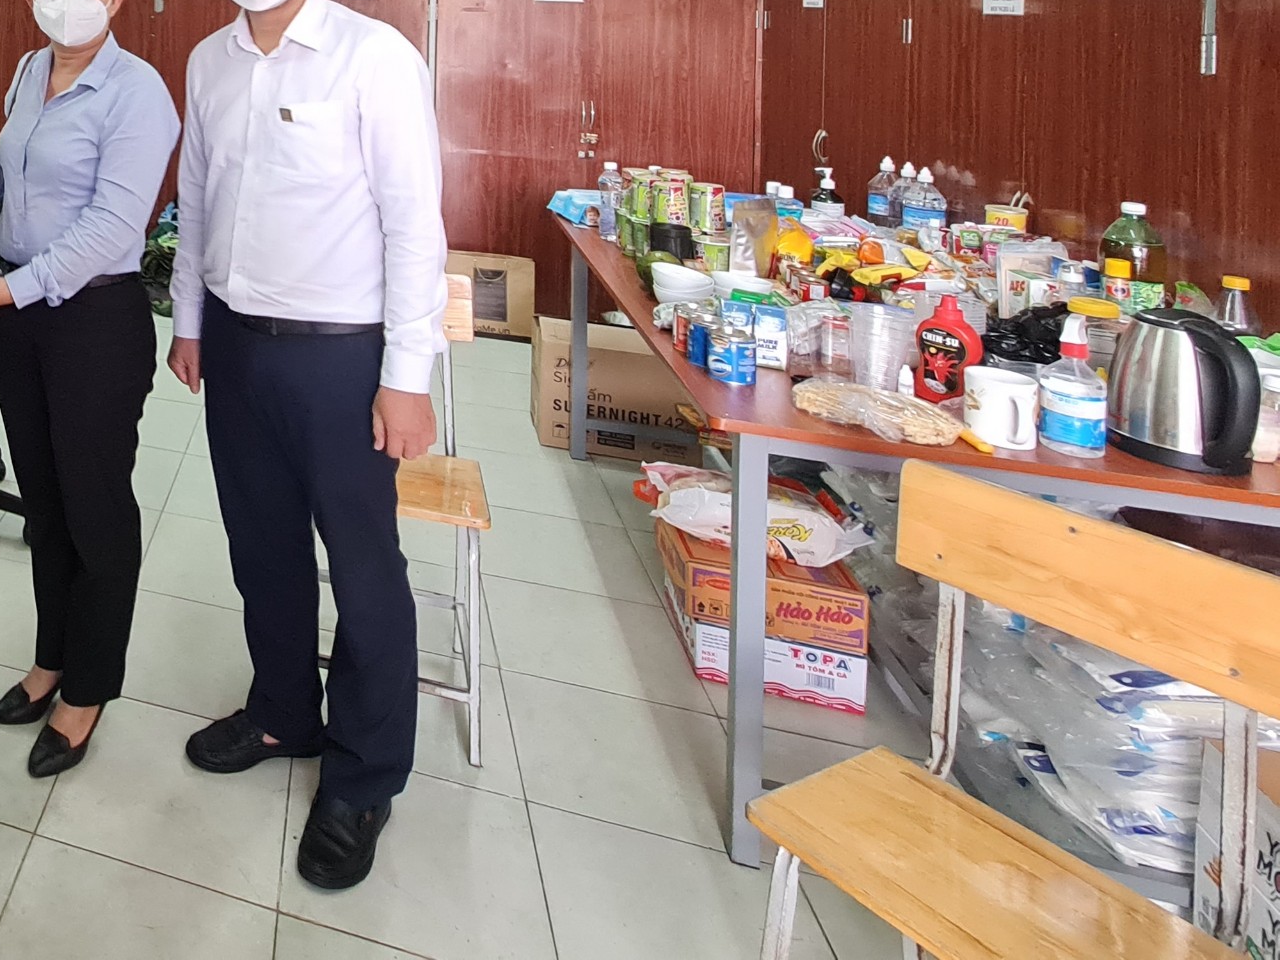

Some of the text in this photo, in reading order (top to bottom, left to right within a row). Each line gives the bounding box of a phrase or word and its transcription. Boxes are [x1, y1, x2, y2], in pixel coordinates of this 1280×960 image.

[995, 216, 1009, 226] 20
[1010, 280, 1025, 291] AFC
[757, 338, 778, 346] PURE
[922, 331, 959, 347] CHIN-SU
[757, 343, 777, 351] MILK
[553, 398, 662, 427] SUERNIGHT
[775, 601, 853, 625] Hảo Hảo
[789, 646, 851, 672] TOPA
